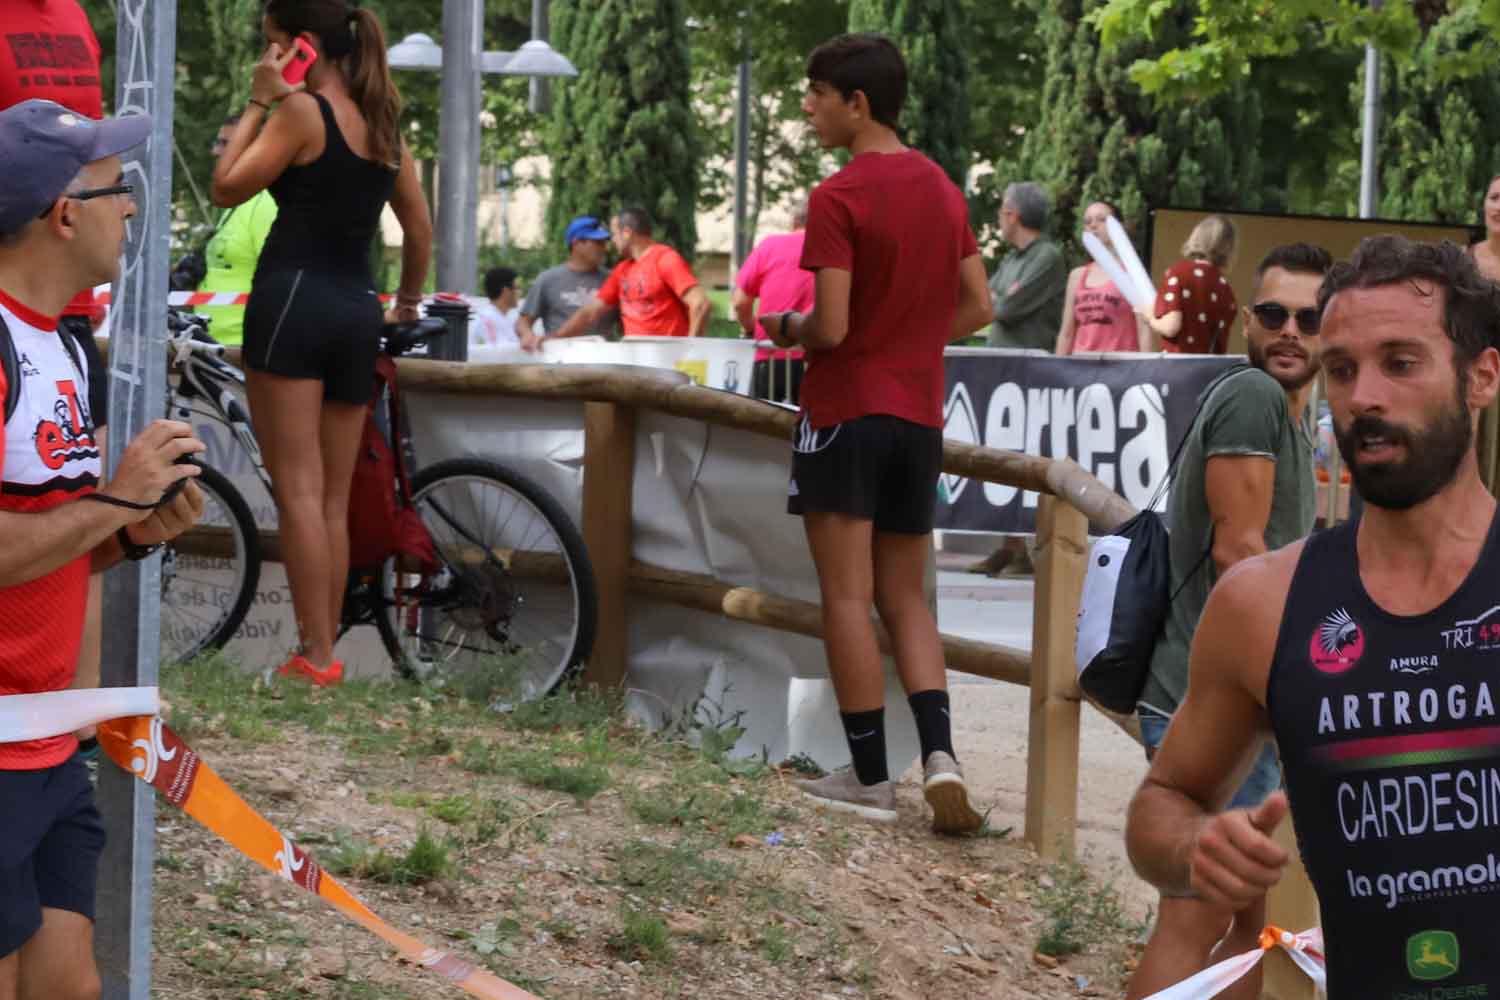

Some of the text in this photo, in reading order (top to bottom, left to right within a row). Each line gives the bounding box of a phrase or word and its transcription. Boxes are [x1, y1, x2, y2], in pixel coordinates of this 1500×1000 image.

[1440, 626, 1475, 649] TRI
[1389, 655, 1439, 670] AMURA
[1347, 869, 1373, 897] la
